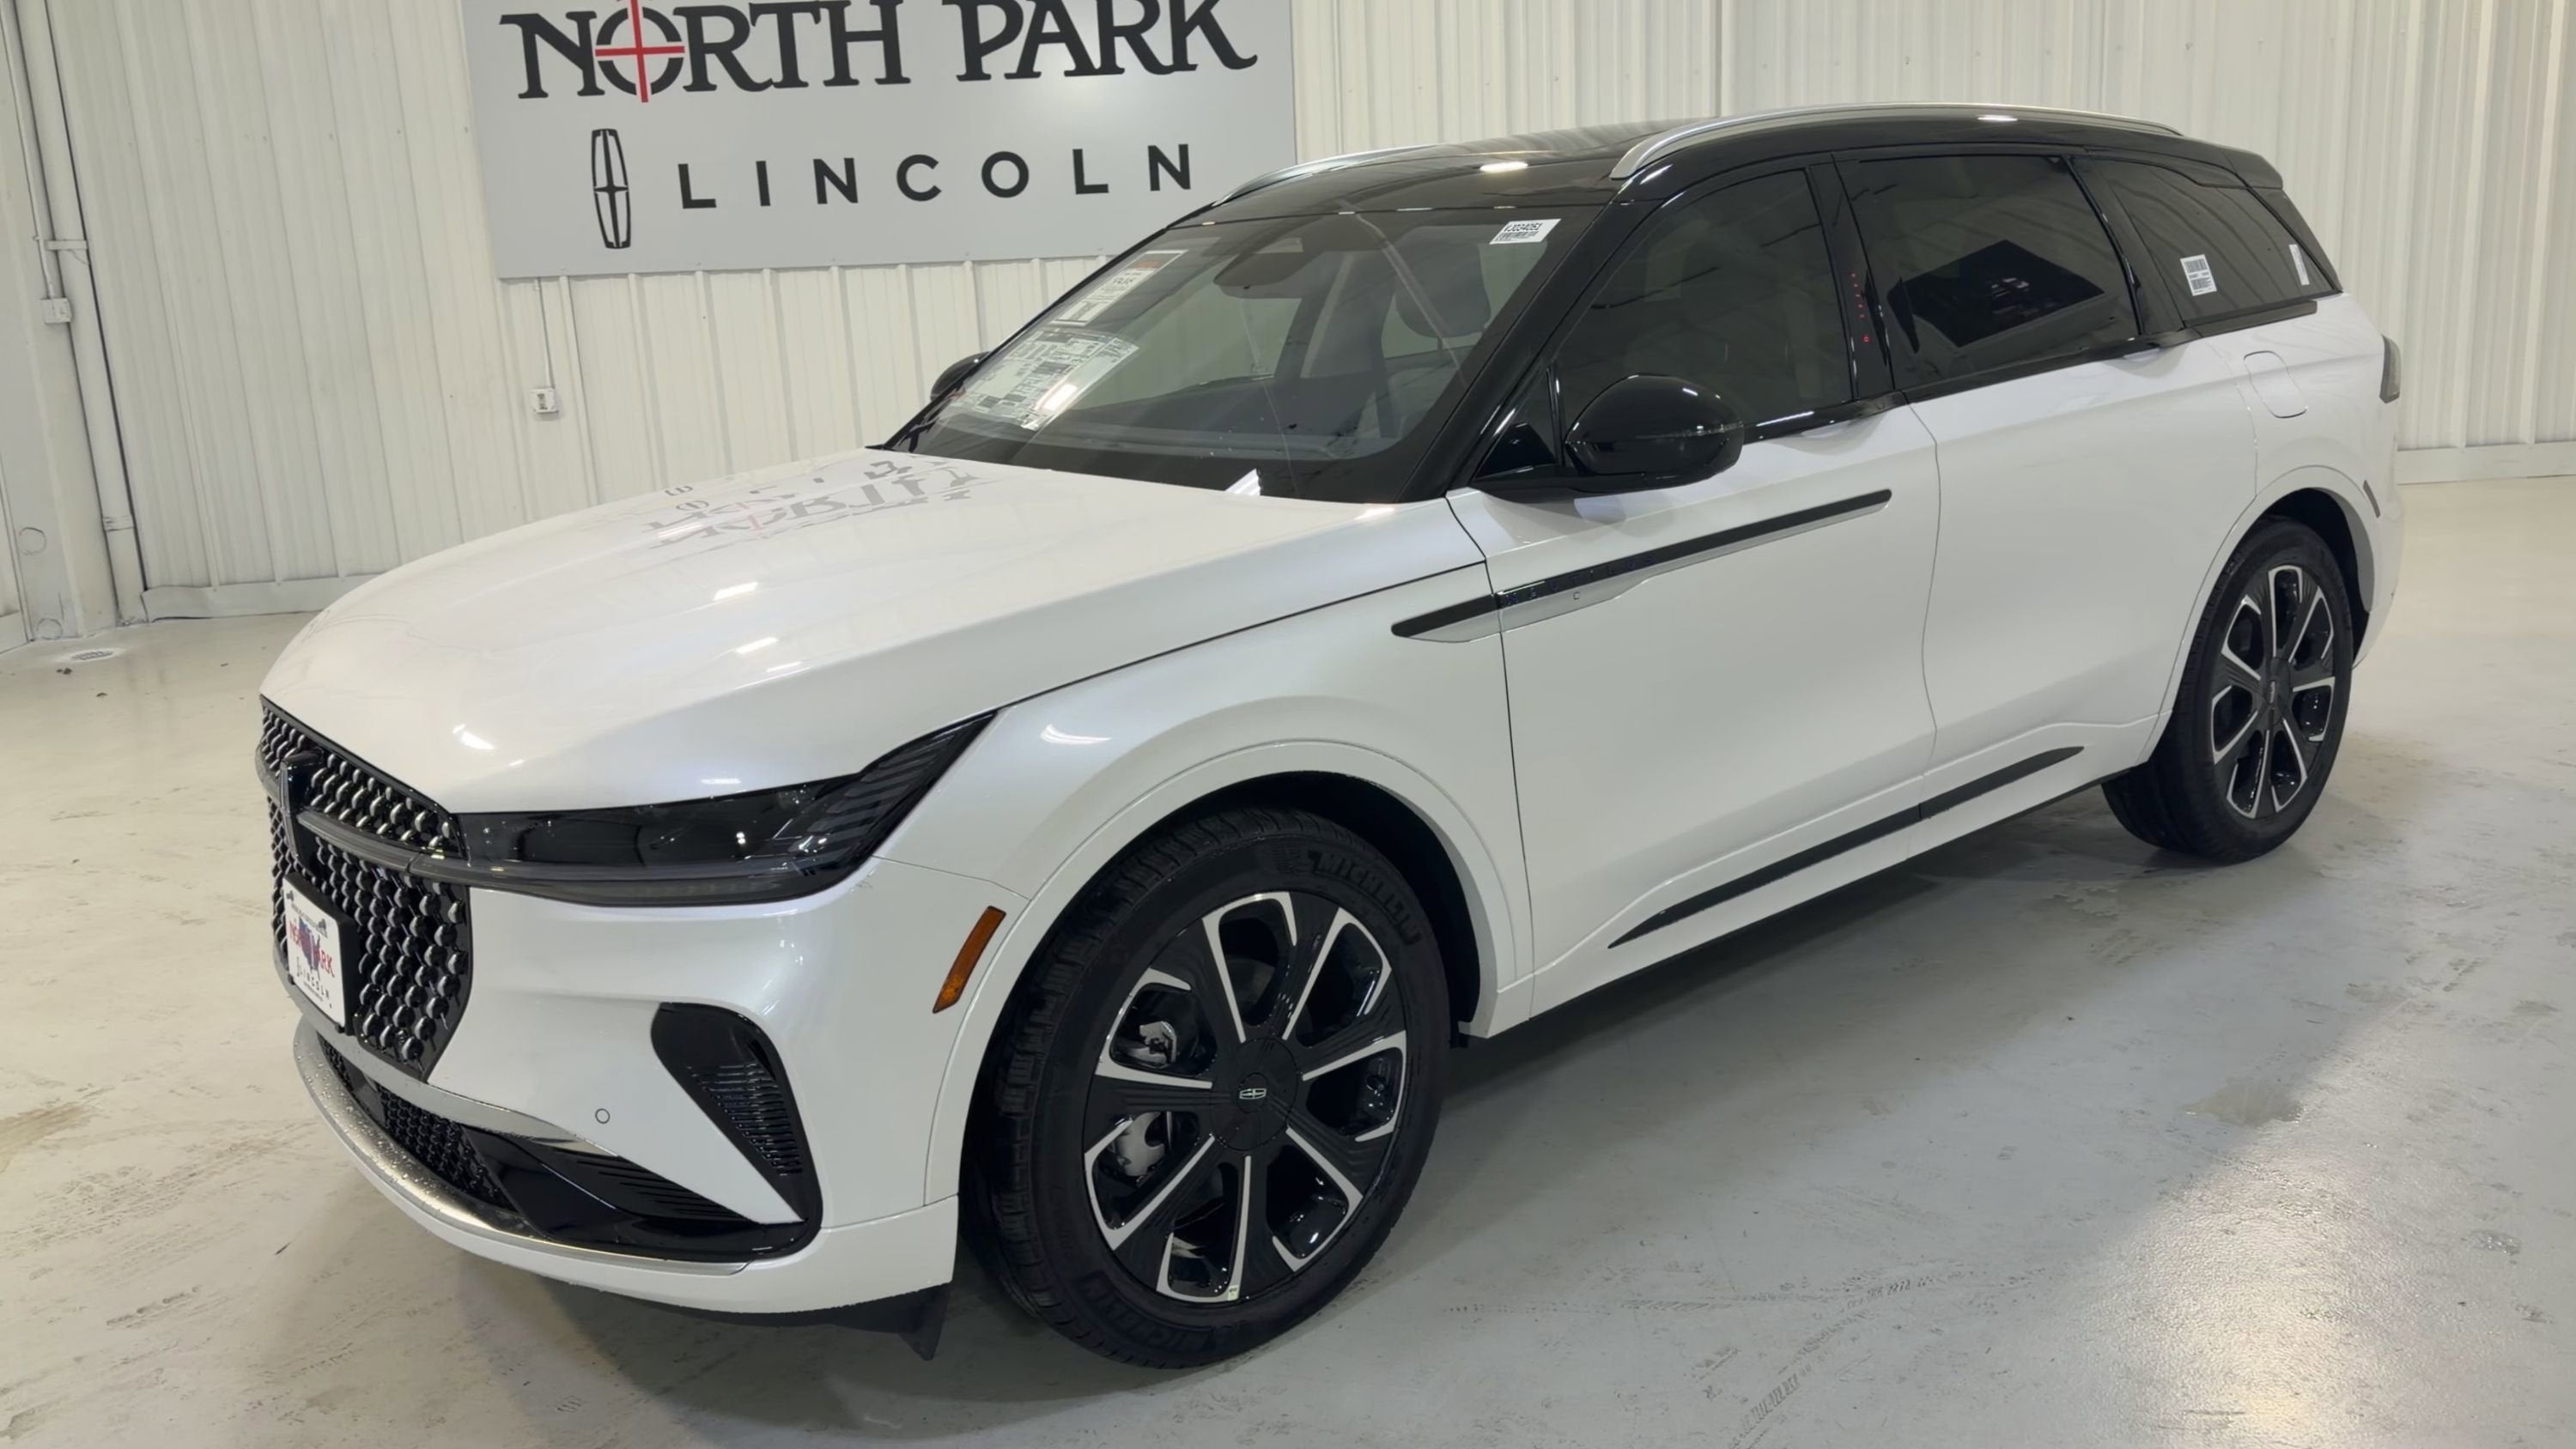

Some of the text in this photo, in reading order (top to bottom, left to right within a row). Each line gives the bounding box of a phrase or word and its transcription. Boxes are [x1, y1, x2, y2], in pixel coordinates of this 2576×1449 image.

[500, 0, 1258, 102] NORTH PARK
[678, 143, 1192, 209] LINCOLN
